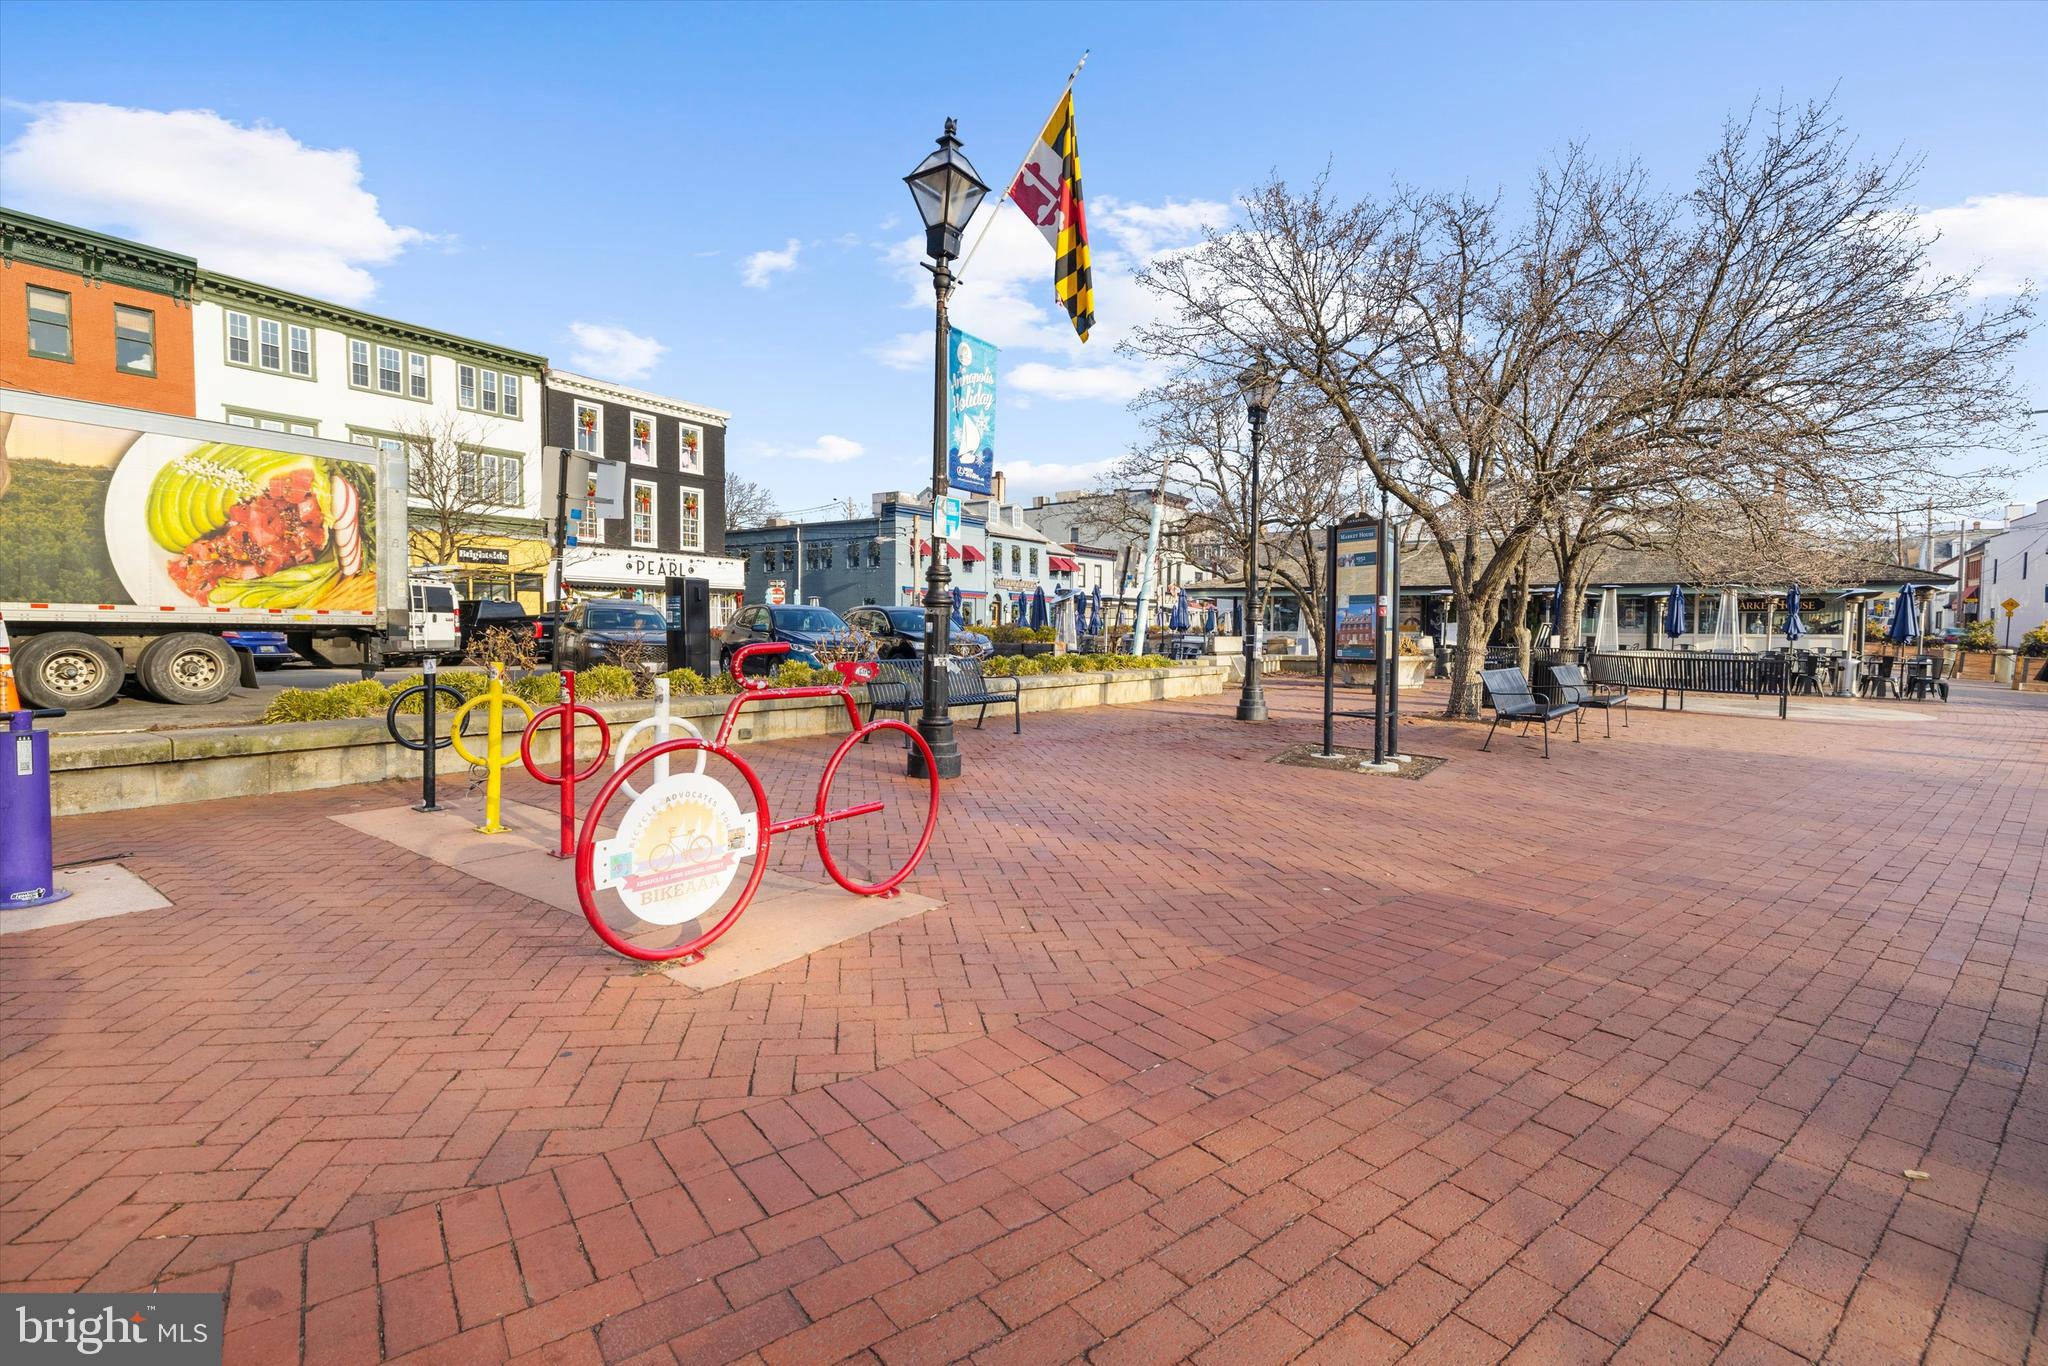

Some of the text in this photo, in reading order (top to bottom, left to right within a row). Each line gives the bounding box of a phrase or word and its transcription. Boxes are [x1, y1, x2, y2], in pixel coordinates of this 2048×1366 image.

[637, 560, 686, 577] PEARL
[664, 791, 718, 808] ADVOCATES
[640, 875, 721, 906] BIKEAAA
